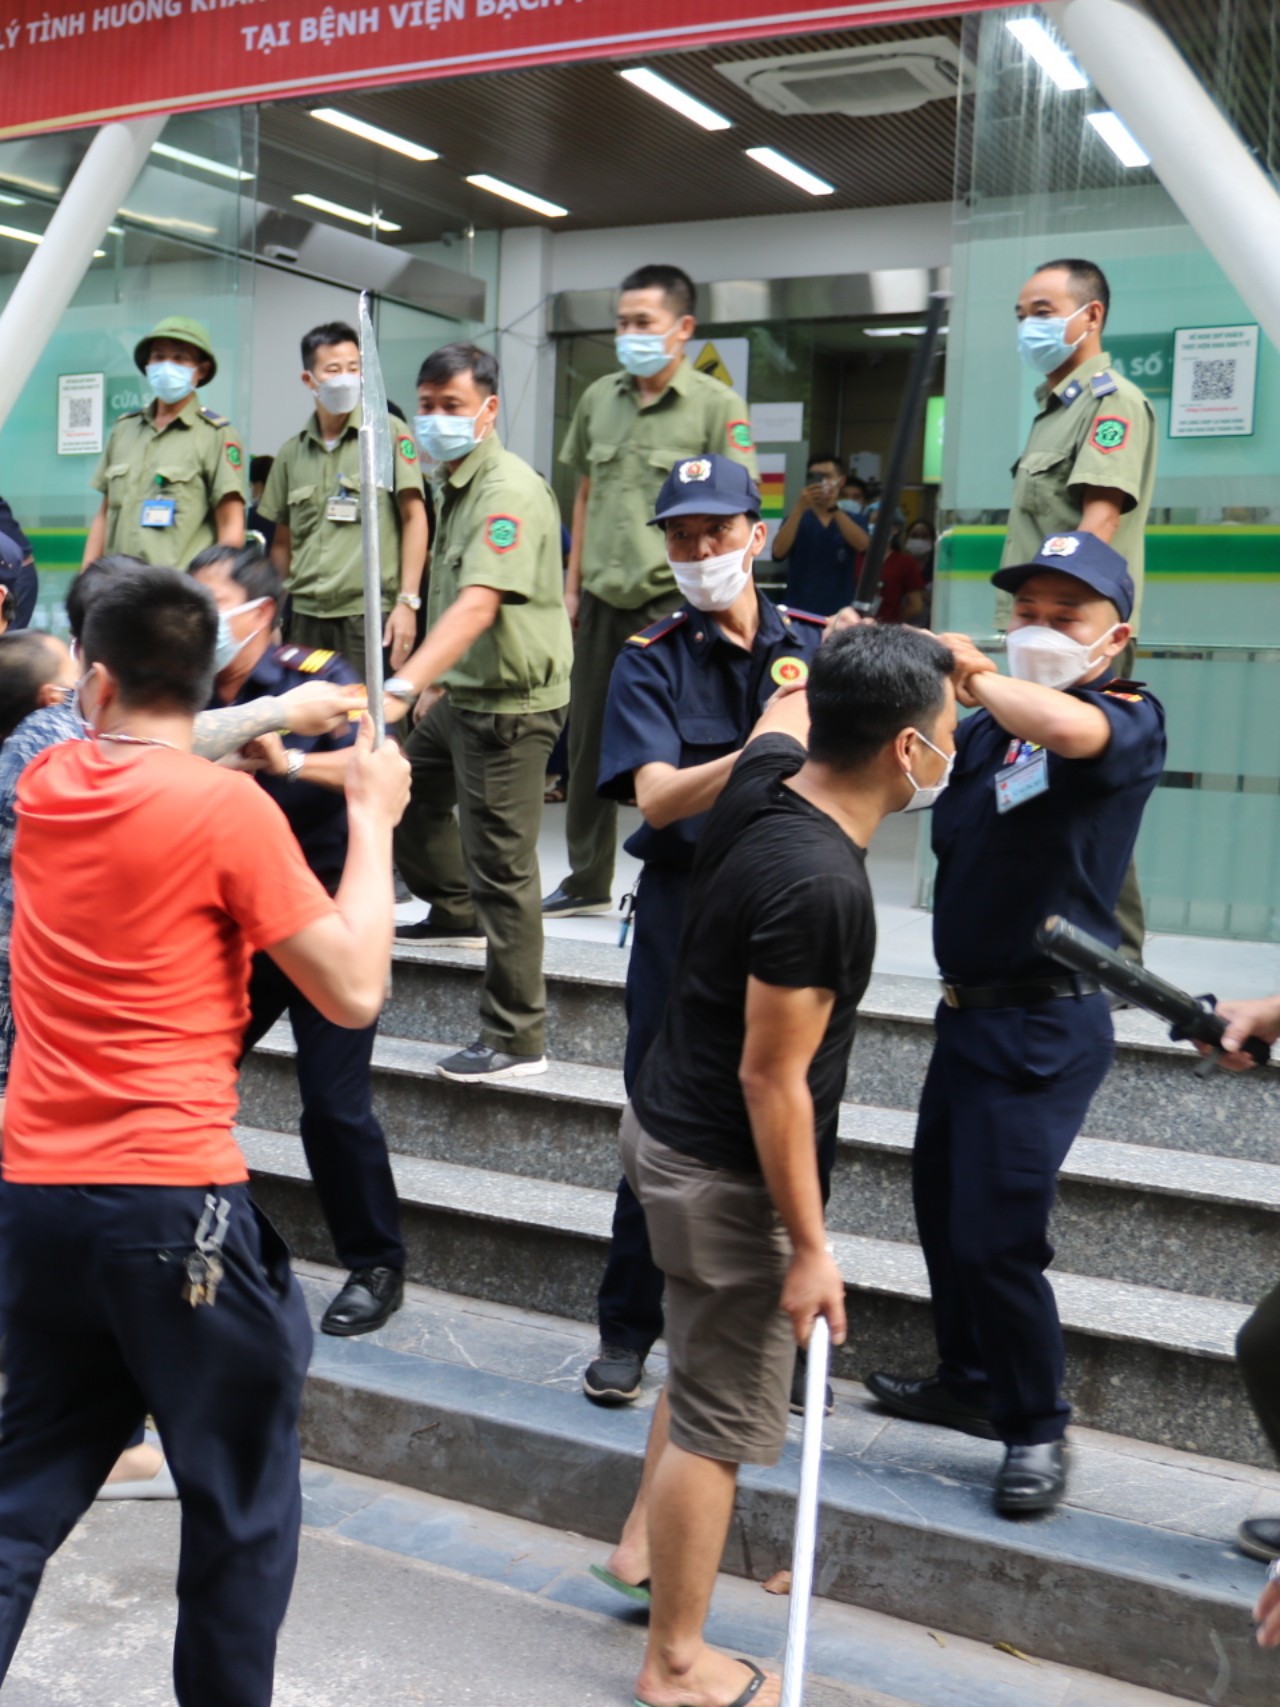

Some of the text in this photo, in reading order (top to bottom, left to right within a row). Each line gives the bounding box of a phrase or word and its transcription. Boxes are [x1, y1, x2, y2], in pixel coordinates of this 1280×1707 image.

[26, 12, 85, 44] TÌNH
[241, 21, 291, 54] TẠI
[299, 7, 379, 46] BỆNH
[389, 0, 465, 31] VIỆN
[1130, 351, 1162, 377] SỐ
